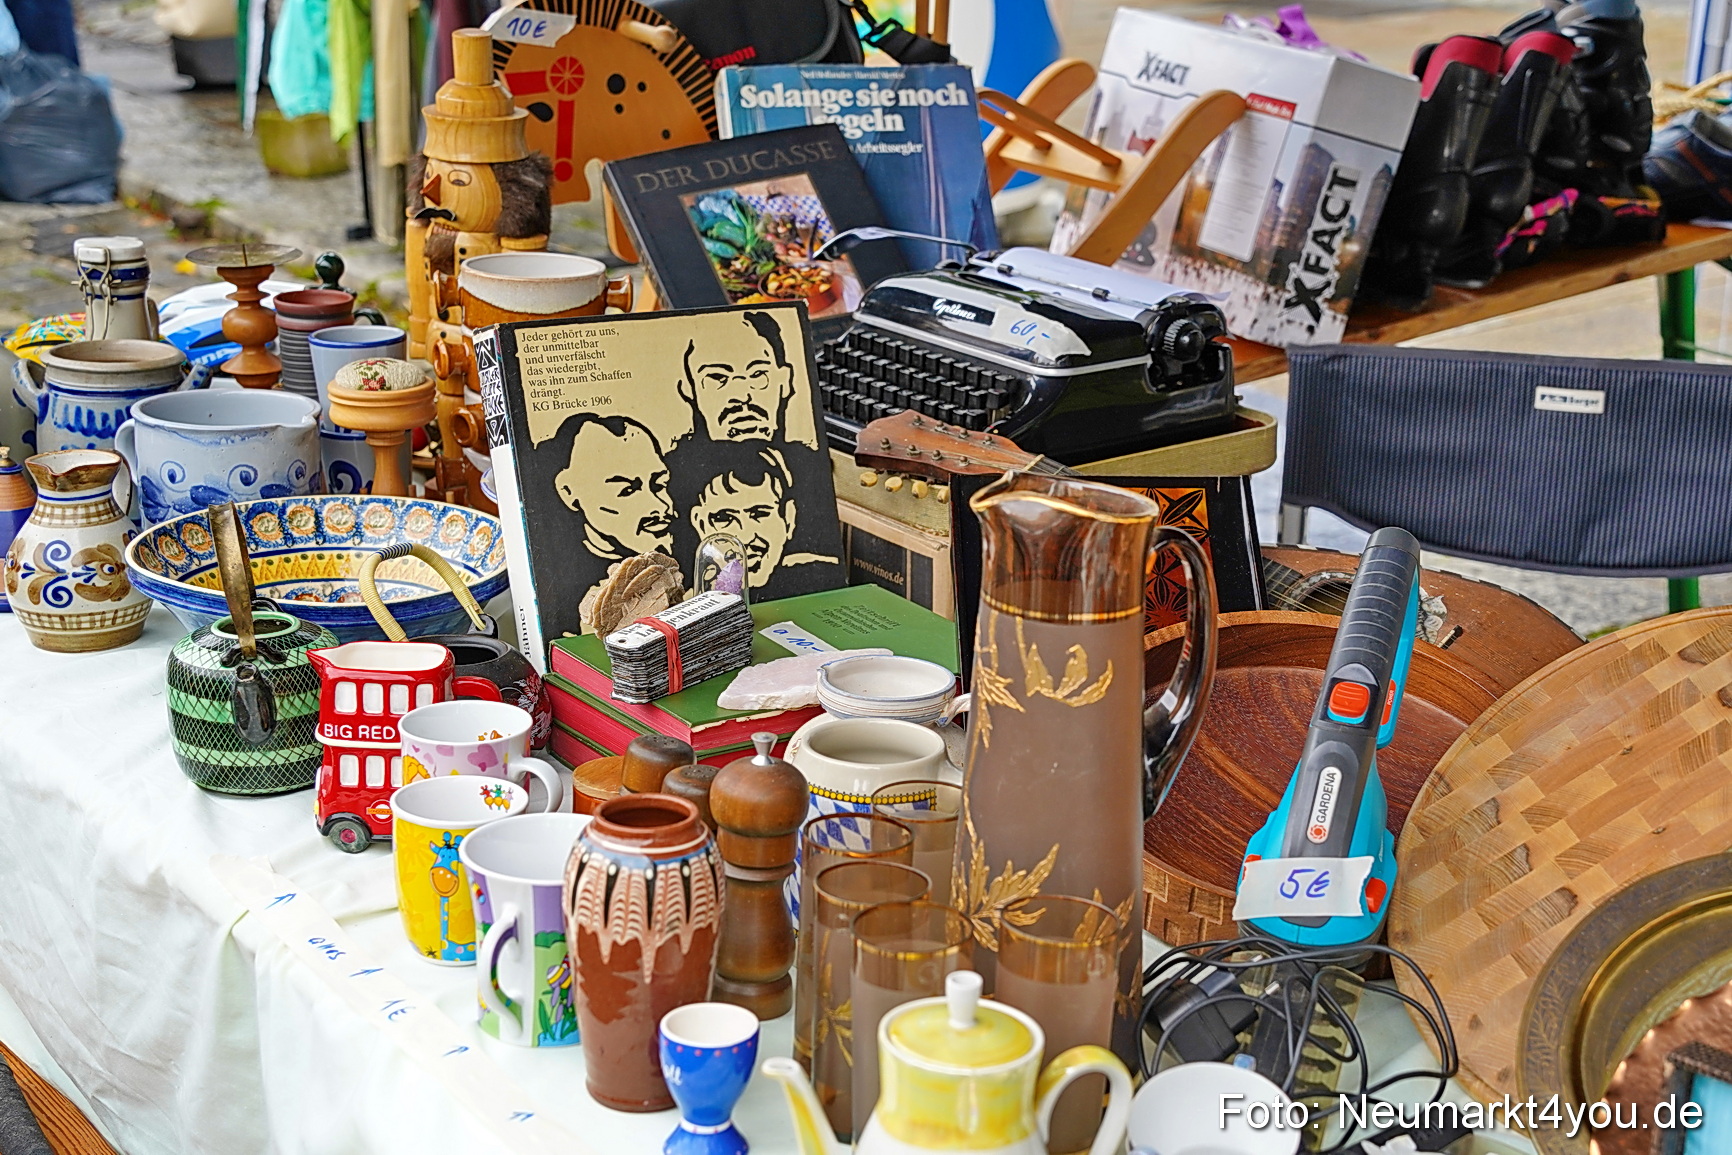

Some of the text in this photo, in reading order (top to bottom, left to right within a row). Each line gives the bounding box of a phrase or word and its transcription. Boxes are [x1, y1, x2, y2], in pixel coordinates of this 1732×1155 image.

[506, 17, 547, 38] 10€
[703, 46, 756, 70] anon
[1137, 51, 1192, 86] XFACT
[740, 82, 969, 114] Solange sie noch
[812, 107, 906, 139] segeln
[634, 141, 837, 194] DER DUCASSE
[1283, 168, 1358, 325] XFACT
[932, 298, 977, 321] Optima
[521, 328, 620, 343] Jeder gehört zu uns,
[523, 339, 600, 354] der unmittelbar
[525, 350, 607, 365] und unverfälscht
[526, 362, 601, 376] das wiedergibt,
[528, 369, 633, 387] was ihn zum Schaffen
[530, 388, 566, 400] drängt.
[532, 395, 613, 412] KG Brücke 1906
[853, 557, 905, 586] www.vinos.de
[324, 723, 396, 740] BIG RED
[1316, 771, 1338, 824] GARDENA
[1280, 868, 1331, 899] 5€
